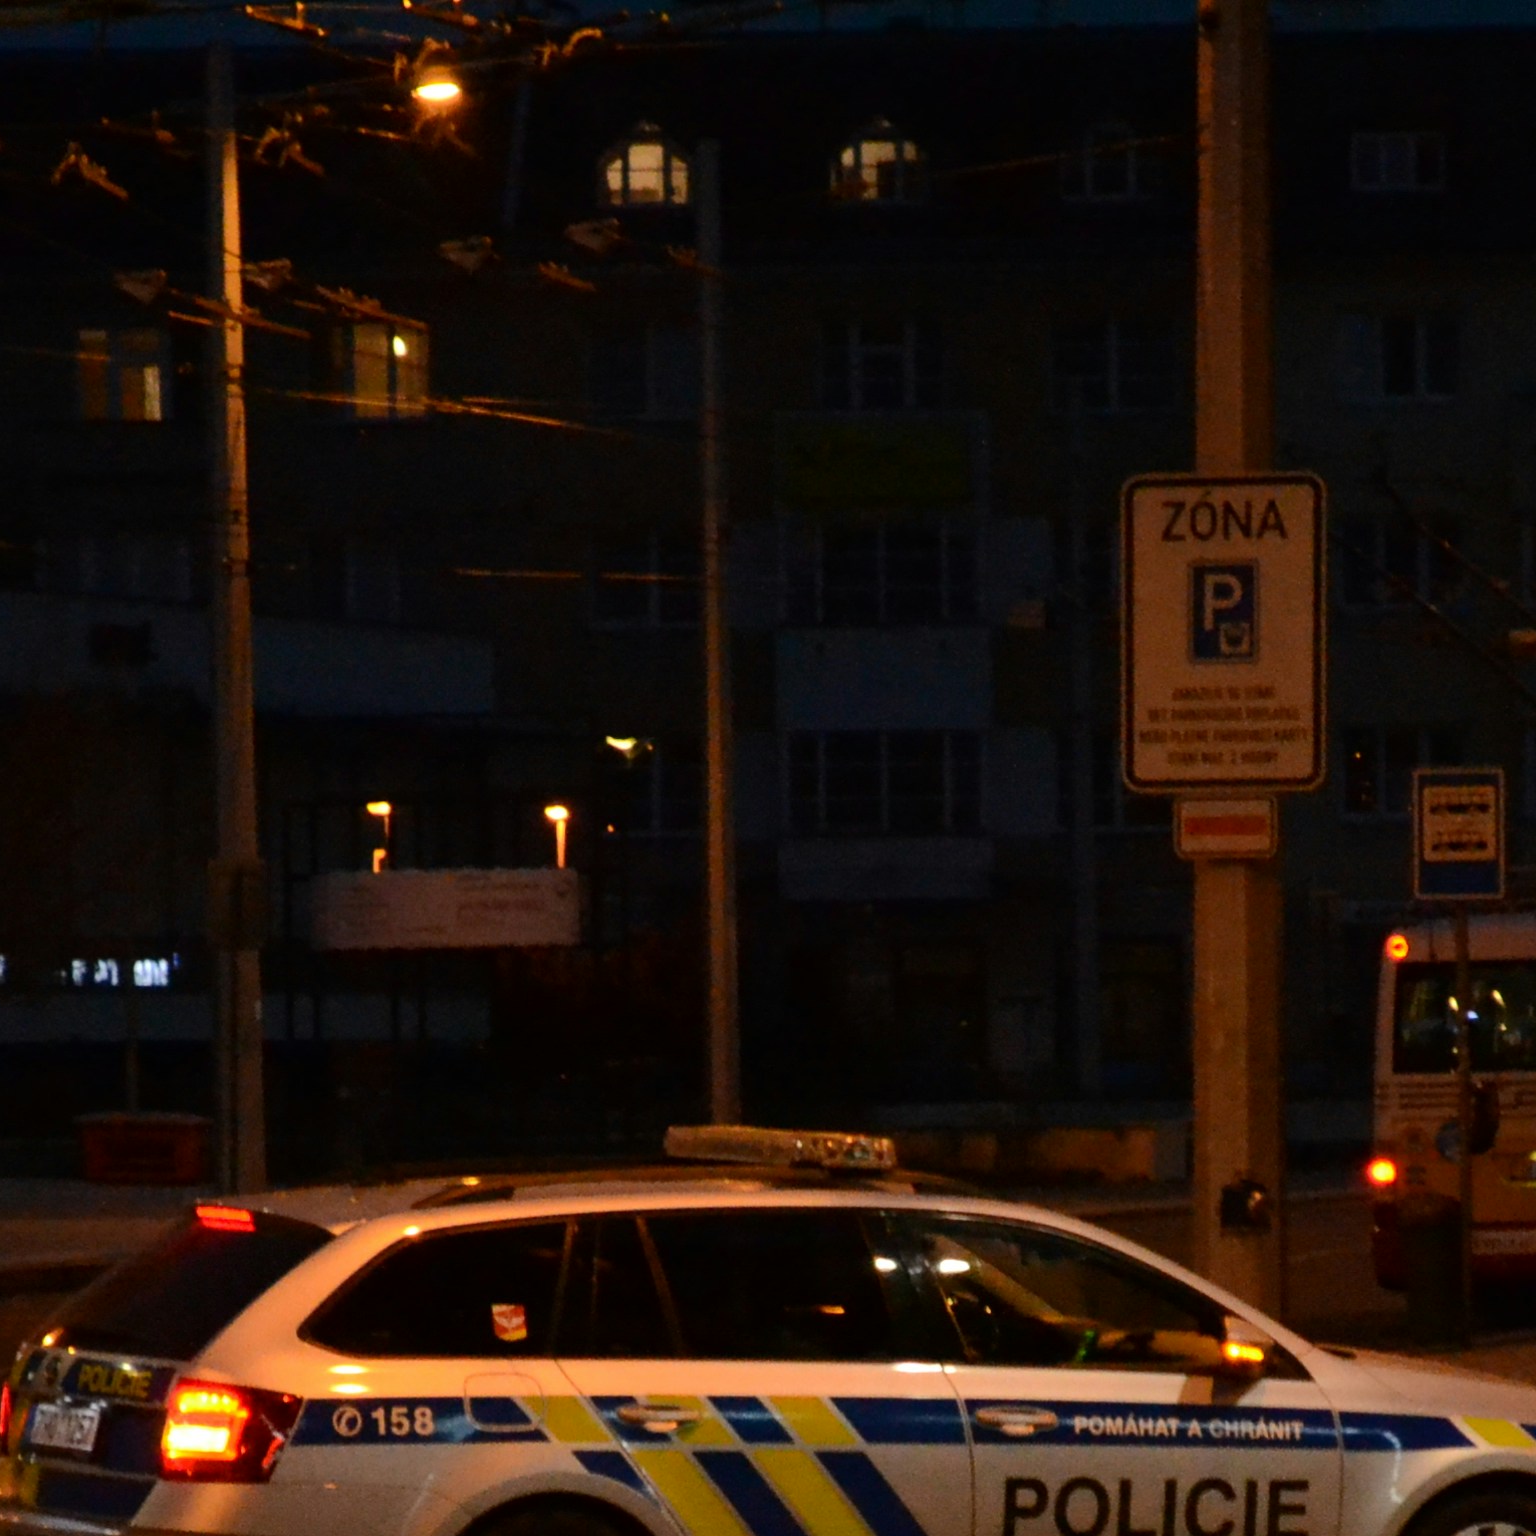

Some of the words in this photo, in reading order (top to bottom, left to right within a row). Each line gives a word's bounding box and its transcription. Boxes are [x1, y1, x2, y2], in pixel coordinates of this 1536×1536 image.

[1161, 492, 1288, 542] ZÓNA
[1204, 573, 1243, 632] P
[370, 1404, 436, 1438] 158
[1073, 1412, 1180, 1439] POMÁHAT
[1187, 1421, 1204, 1439] A
[1208, 1413, 1304, 1441] CHRÁNIT
